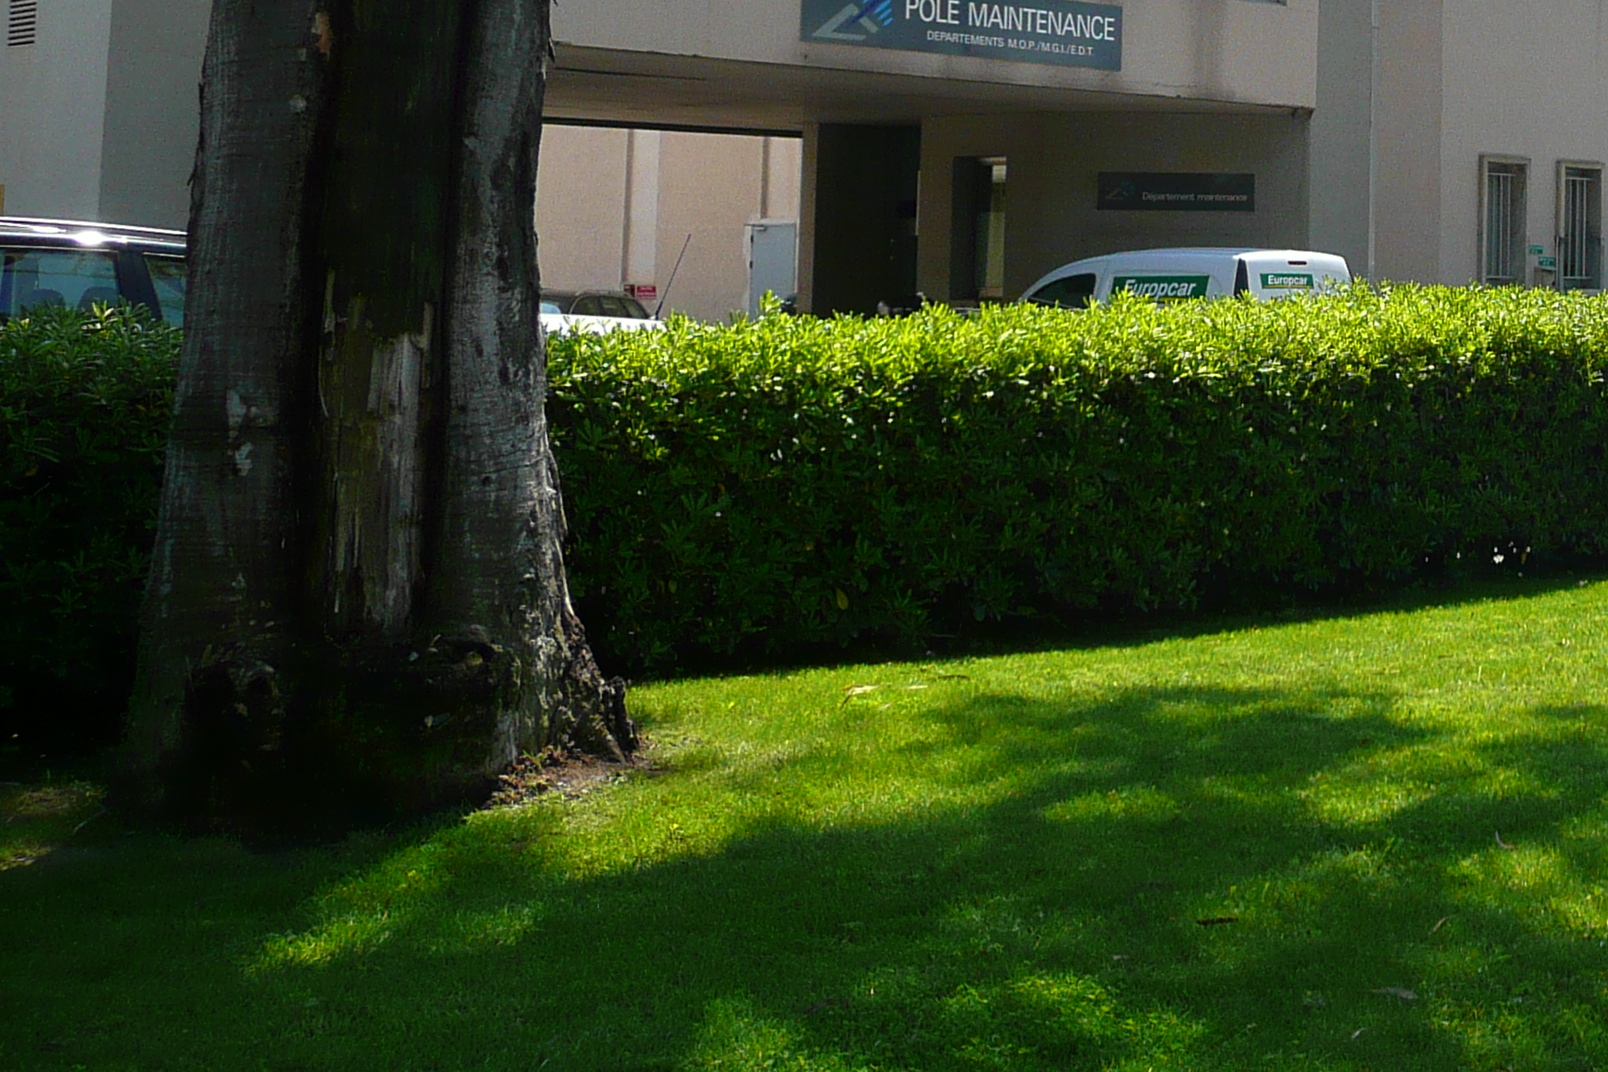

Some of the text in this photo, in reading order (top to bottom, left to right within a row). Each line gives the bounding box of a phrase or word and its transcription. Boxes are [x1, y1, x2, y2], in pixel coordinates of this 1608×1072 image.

[968, 1, 1116, 41] MAINTENANCE
[926, 30, 1005, 48] DEPARTEMENTS
[1197, 193, 1248, 202] maintenance
[1267, 274, 1308, 286] Europcar
[1124, 278, 1197, 302] Europcar
